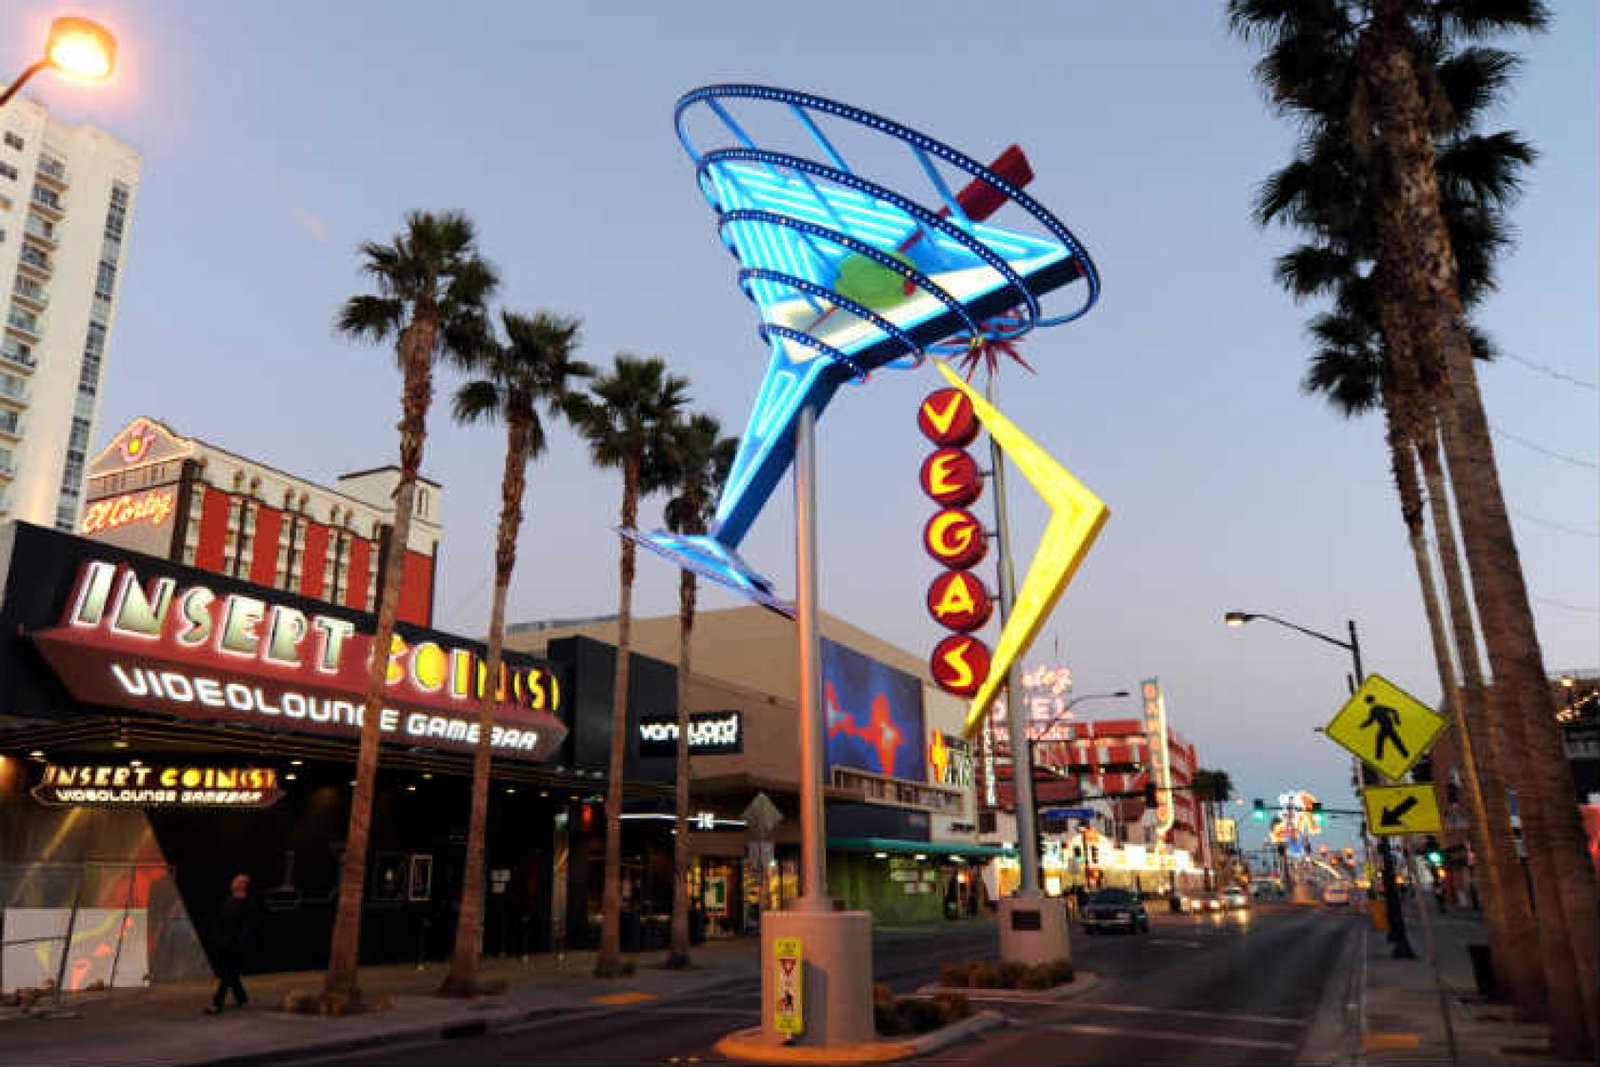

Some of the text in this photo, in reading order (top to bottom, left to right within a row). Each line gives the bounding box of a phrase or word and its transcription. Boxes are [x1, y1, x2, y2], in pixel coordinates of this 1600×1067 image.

[923, 391, 975, 688] VEGAS
[70, 562, 355, 674] INSERT
[111, 664, 399, 732] VIDEOLOUNE
[640, 713, 738, 744] vanuard
[44, 766, 151, 787] INSERT
